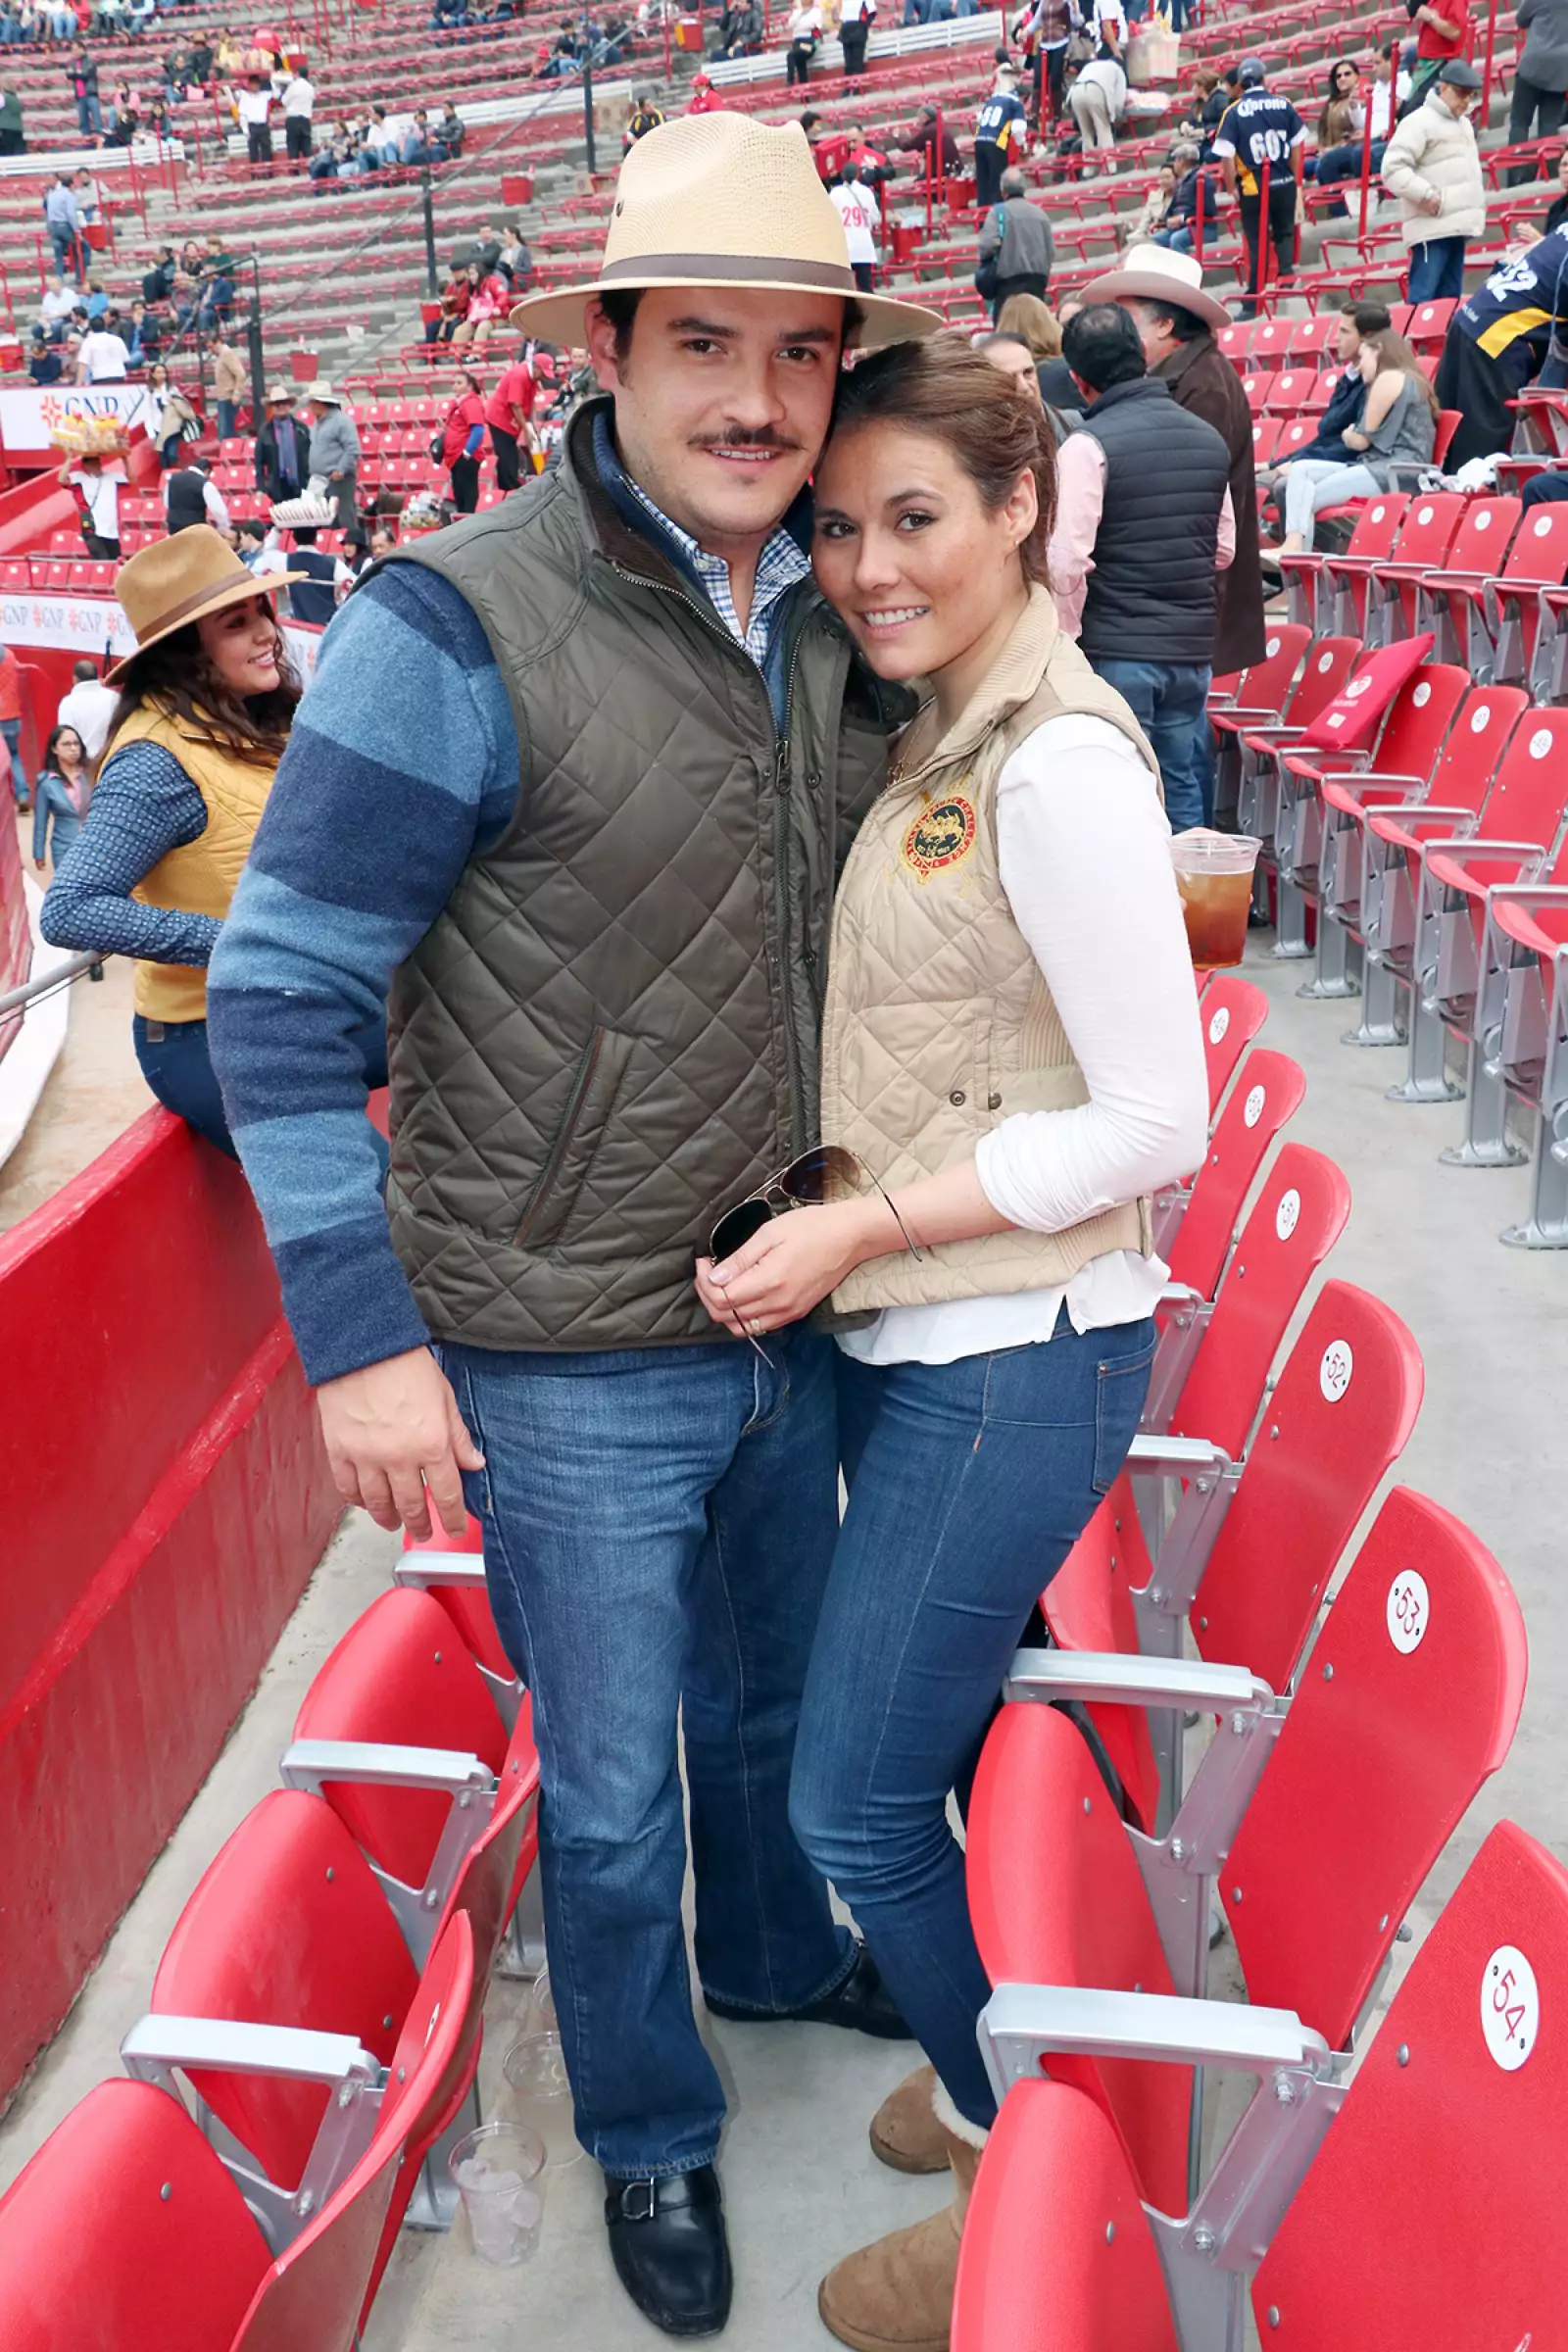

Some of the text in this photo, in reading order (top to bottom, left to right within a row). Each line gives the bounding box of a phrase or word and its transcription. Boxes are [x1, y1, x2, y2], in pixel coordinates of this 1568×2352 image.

[1327, 1352, 1346, 1389] 52
[1396, 1587, 1420, 1636] 53
[1494, 1969, 1526, 2042] 54
